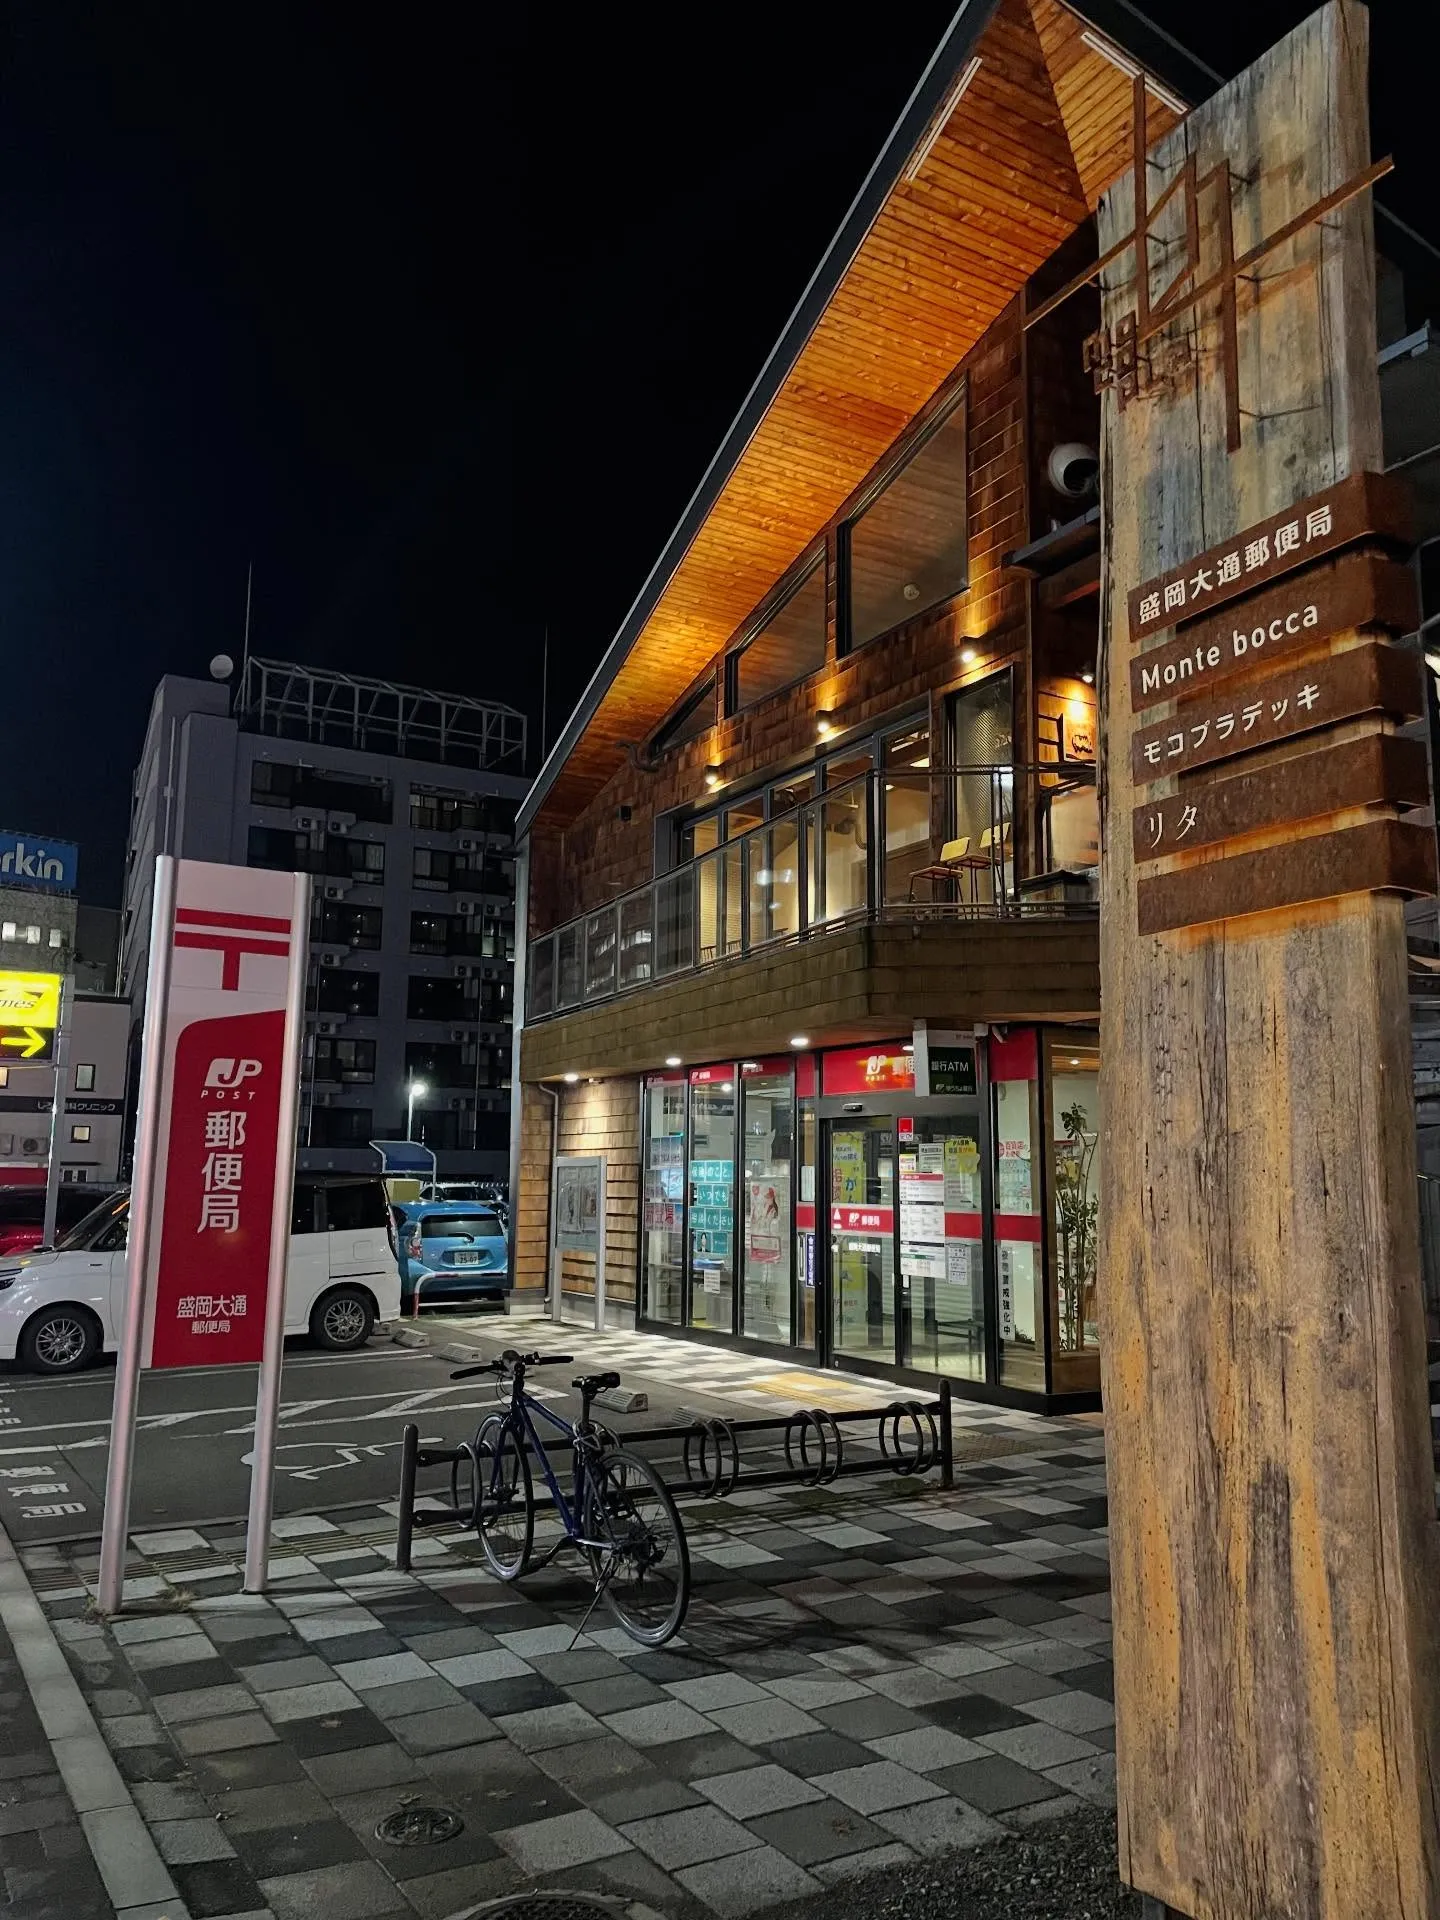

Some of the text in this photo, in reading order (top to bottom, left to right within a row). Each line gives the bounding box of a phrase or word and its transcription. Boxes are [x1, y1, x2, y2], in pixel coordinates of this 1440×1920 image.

[1138, 504, 1333, 625] 盛岡大通郵便局
[1141, 602, 1319, 695] Monte bocca
[1143, 683, 1322, 765] モコプラデッキ
[1147, 804, 1198, 849] リタ
[0, 842, 64, 881] rkin
[200, 1089, 256, 1100] POST
[197, 1110, 247, 1233] 郵便局
[176, 1294, 247, 1319] 盛岡大通
[191, 1319, 231, 1334] 郵便局
